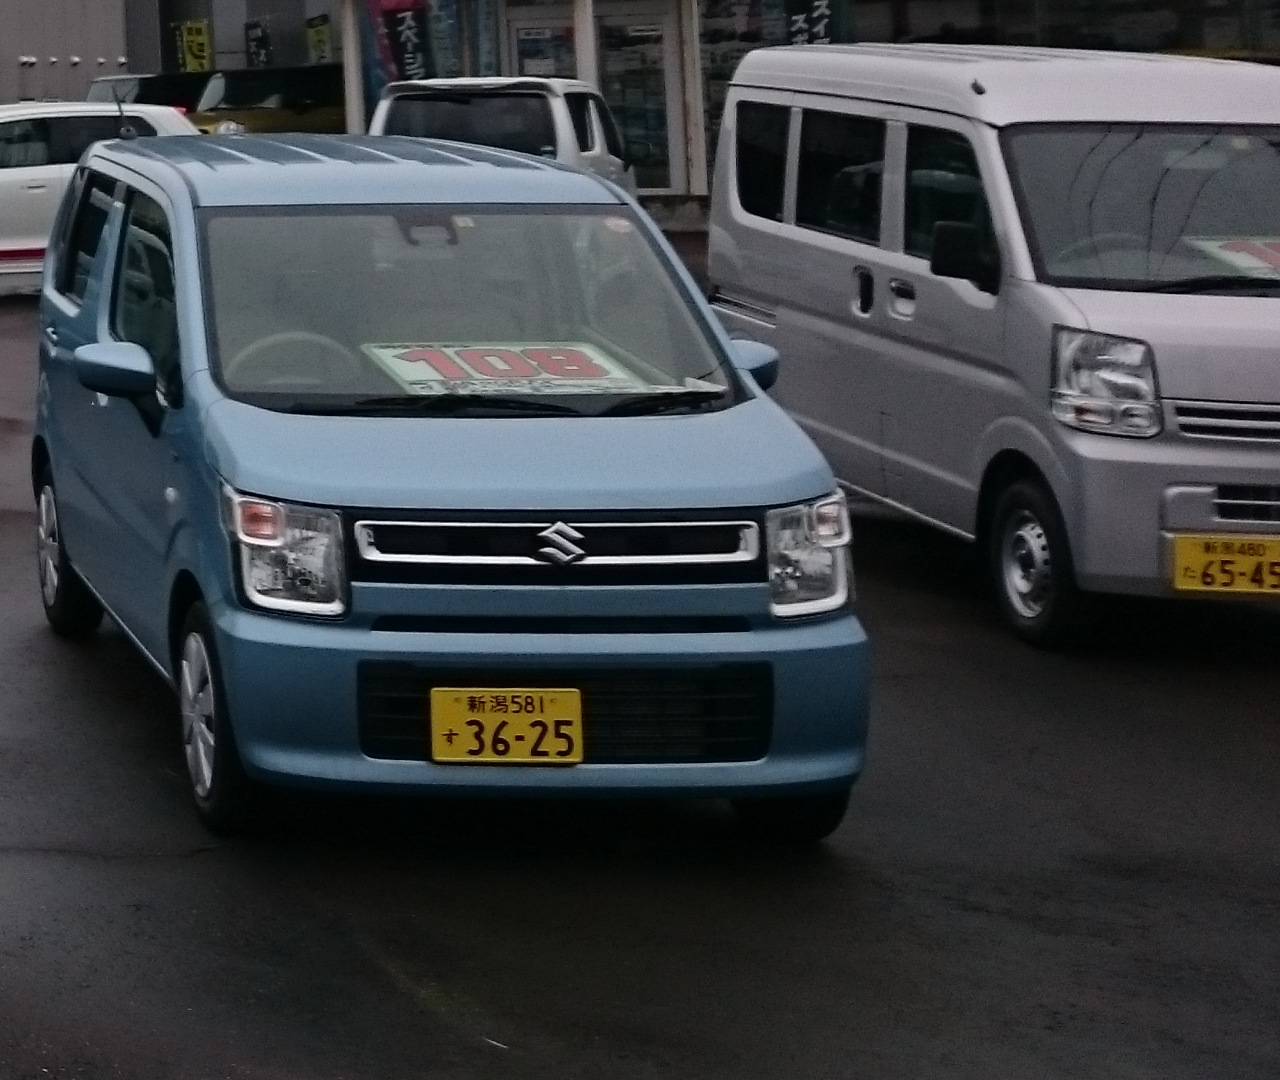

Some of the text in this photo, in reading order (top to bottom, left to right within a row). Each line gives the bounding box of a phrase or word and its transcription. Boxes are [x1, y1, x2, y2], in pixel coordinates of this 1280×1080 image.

[392, 347, 611, 380] 108
[467, 695, 545, 714] 新潟581
[442, 719, 575, 757] す 36-25
